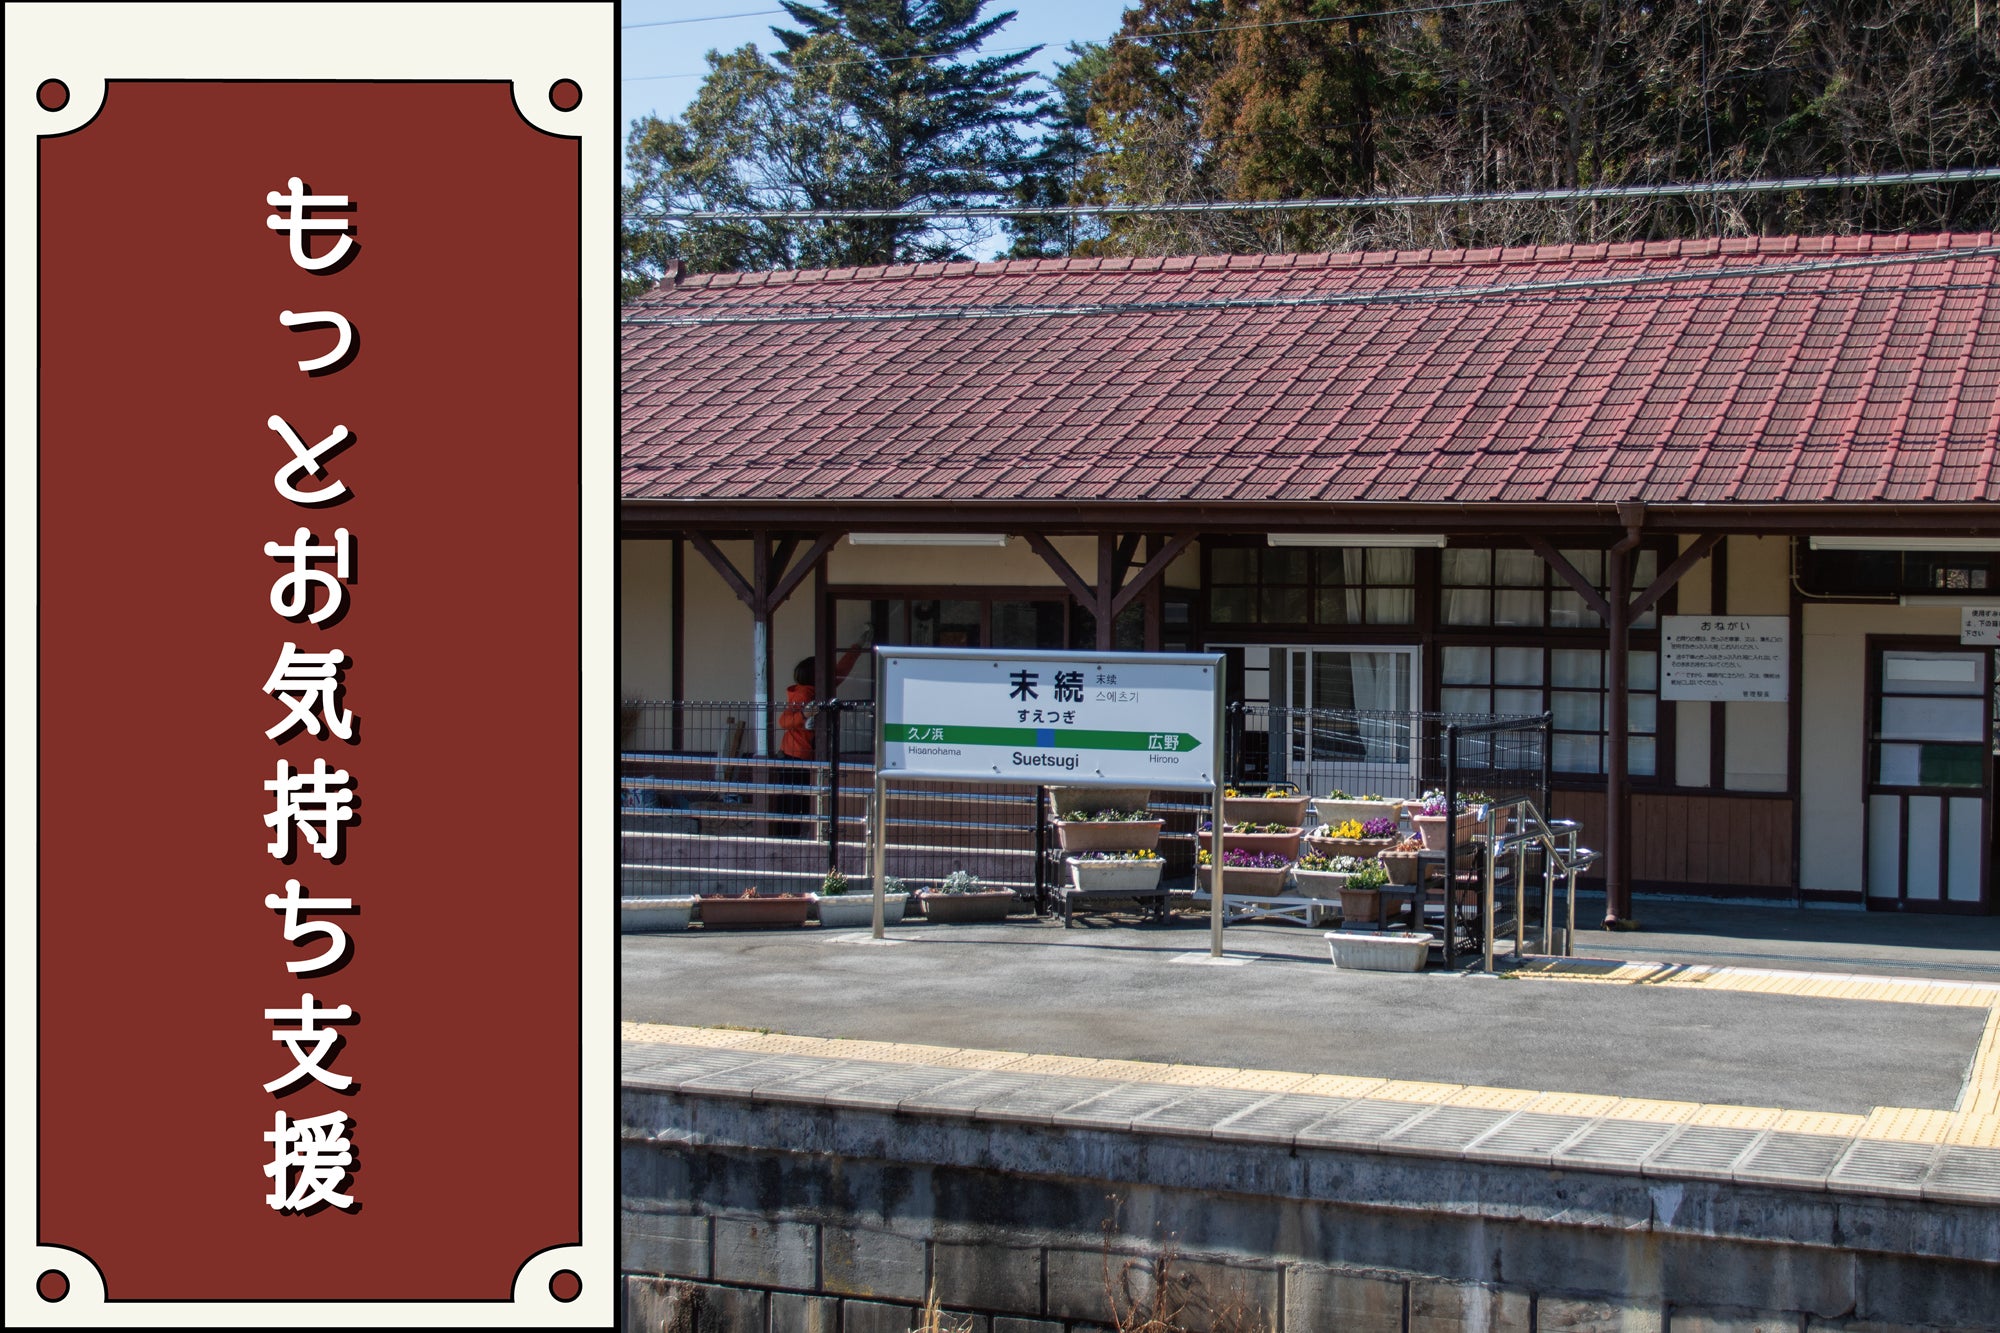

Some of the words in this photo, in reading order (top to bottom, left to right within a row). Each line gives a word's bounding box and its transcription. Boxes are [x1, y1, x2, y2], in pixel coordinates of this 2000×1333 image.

[1700, 621, 1751, 632] おねがい
[1009, 669, 1085, 703] 末続
[1095, 673, 1118, 686] 末续
[1095, 691, 1139, 703] 스에츠기
[1017, 708, 1076, 724] すえつぎ
[908, 727, 944, 741] 久ノ浜
[1148, 733, 1179, 751] 広野
[908, 745, 962, 756] Hisanohama
[1012, 751, 1079, 771] Suetsugi
[1149, 754, 1180, 764] Hirono
